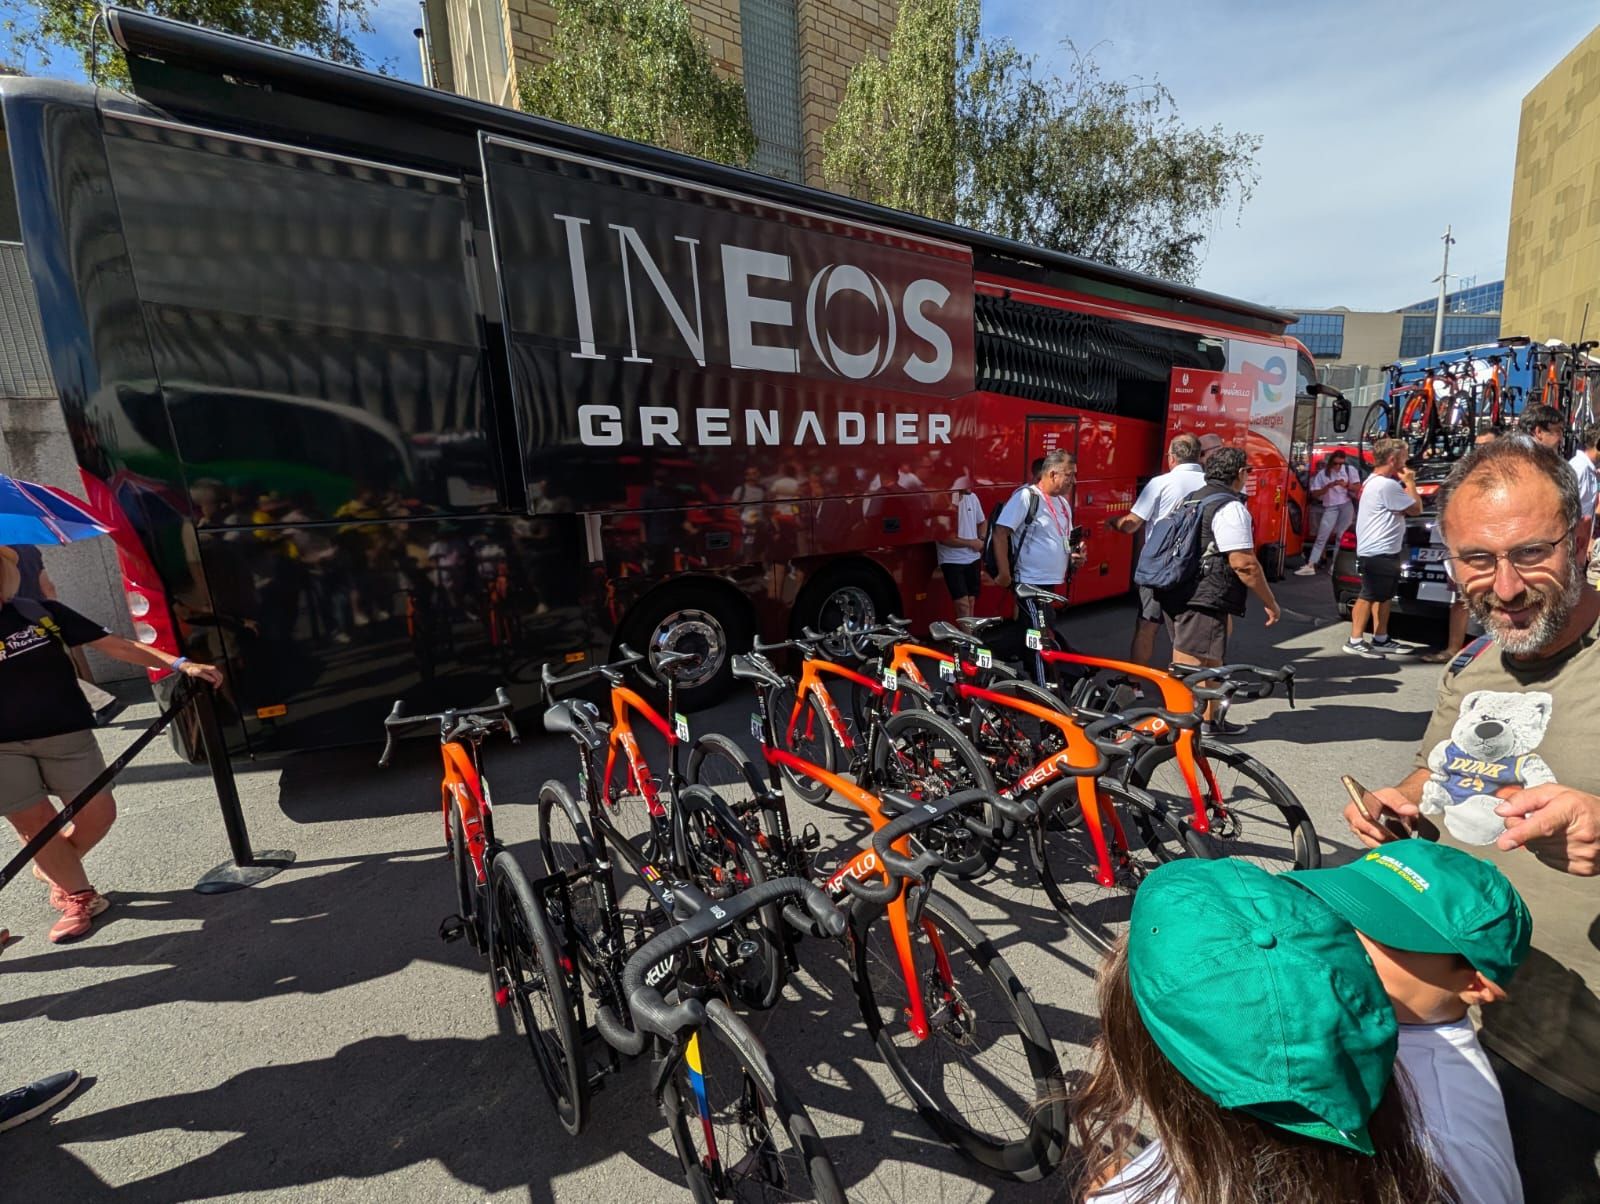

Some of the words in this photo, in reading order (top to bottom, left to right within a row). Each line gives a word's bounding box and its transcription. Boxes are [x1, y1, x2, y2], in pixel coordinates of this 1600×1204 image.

[553, 213, 954, 384] INEOS
[577, 404, 953, 447] GRENADIER
[981, 655, 990, 668] 67
[886, 675, 895, 690] 65
[1447, 757, 1509, 779] DUNK
